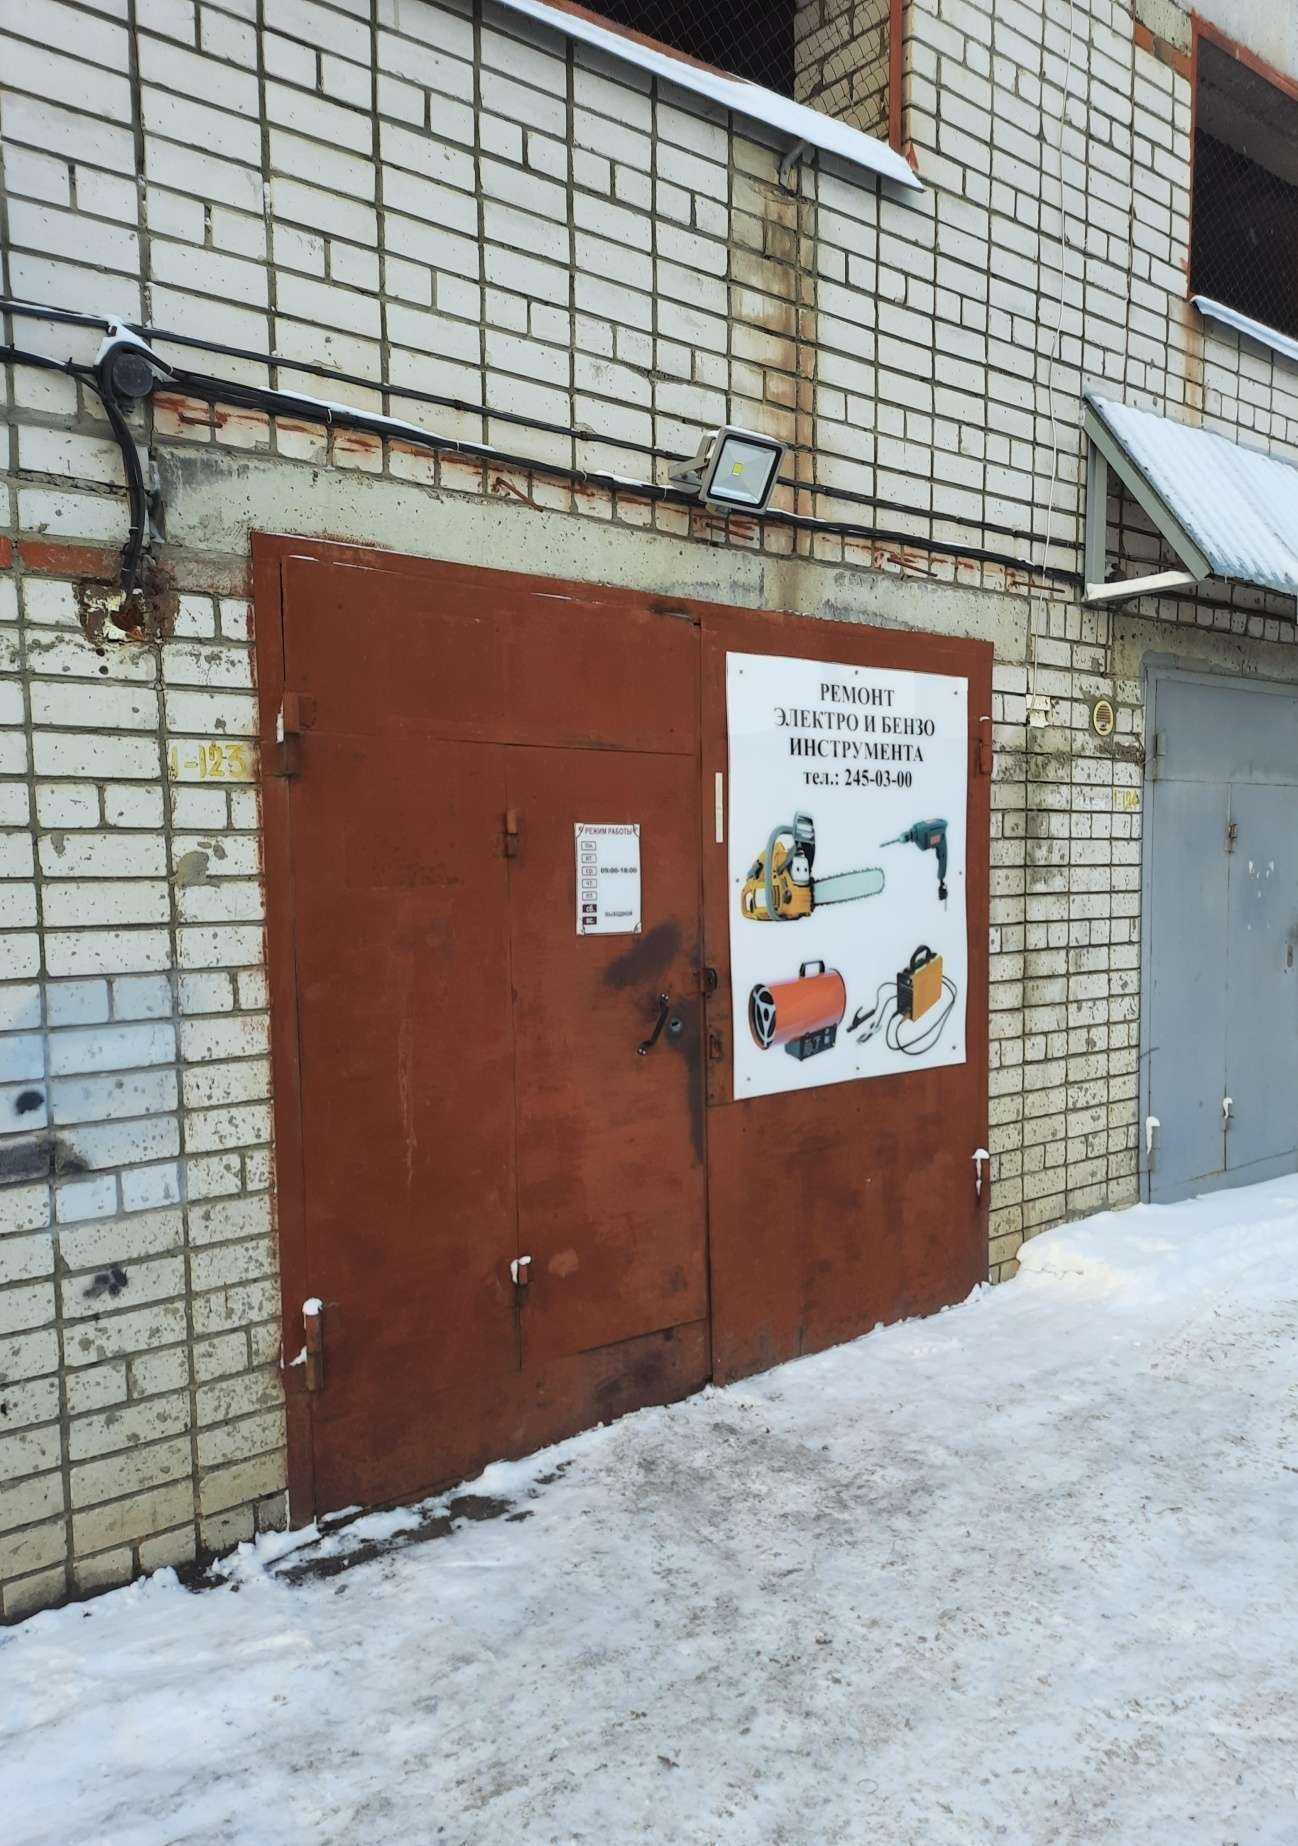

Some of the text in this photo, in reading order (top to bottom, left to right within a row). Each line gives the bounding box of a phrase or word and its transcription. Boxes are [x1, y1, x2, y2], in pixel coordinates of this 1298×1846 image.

[820, 683, 895, 707] РЕМОНТ
[773, 708, 935, 737] ЭЛЕКТРО И БЕНЗО
[789, 737, 924, 762] ИНСТРУМЕНТА
[803, 768, 913, 788] тел.: 245-03-00
[585, 827, 632, 836] РЕЖИМ РАБОТЫ
